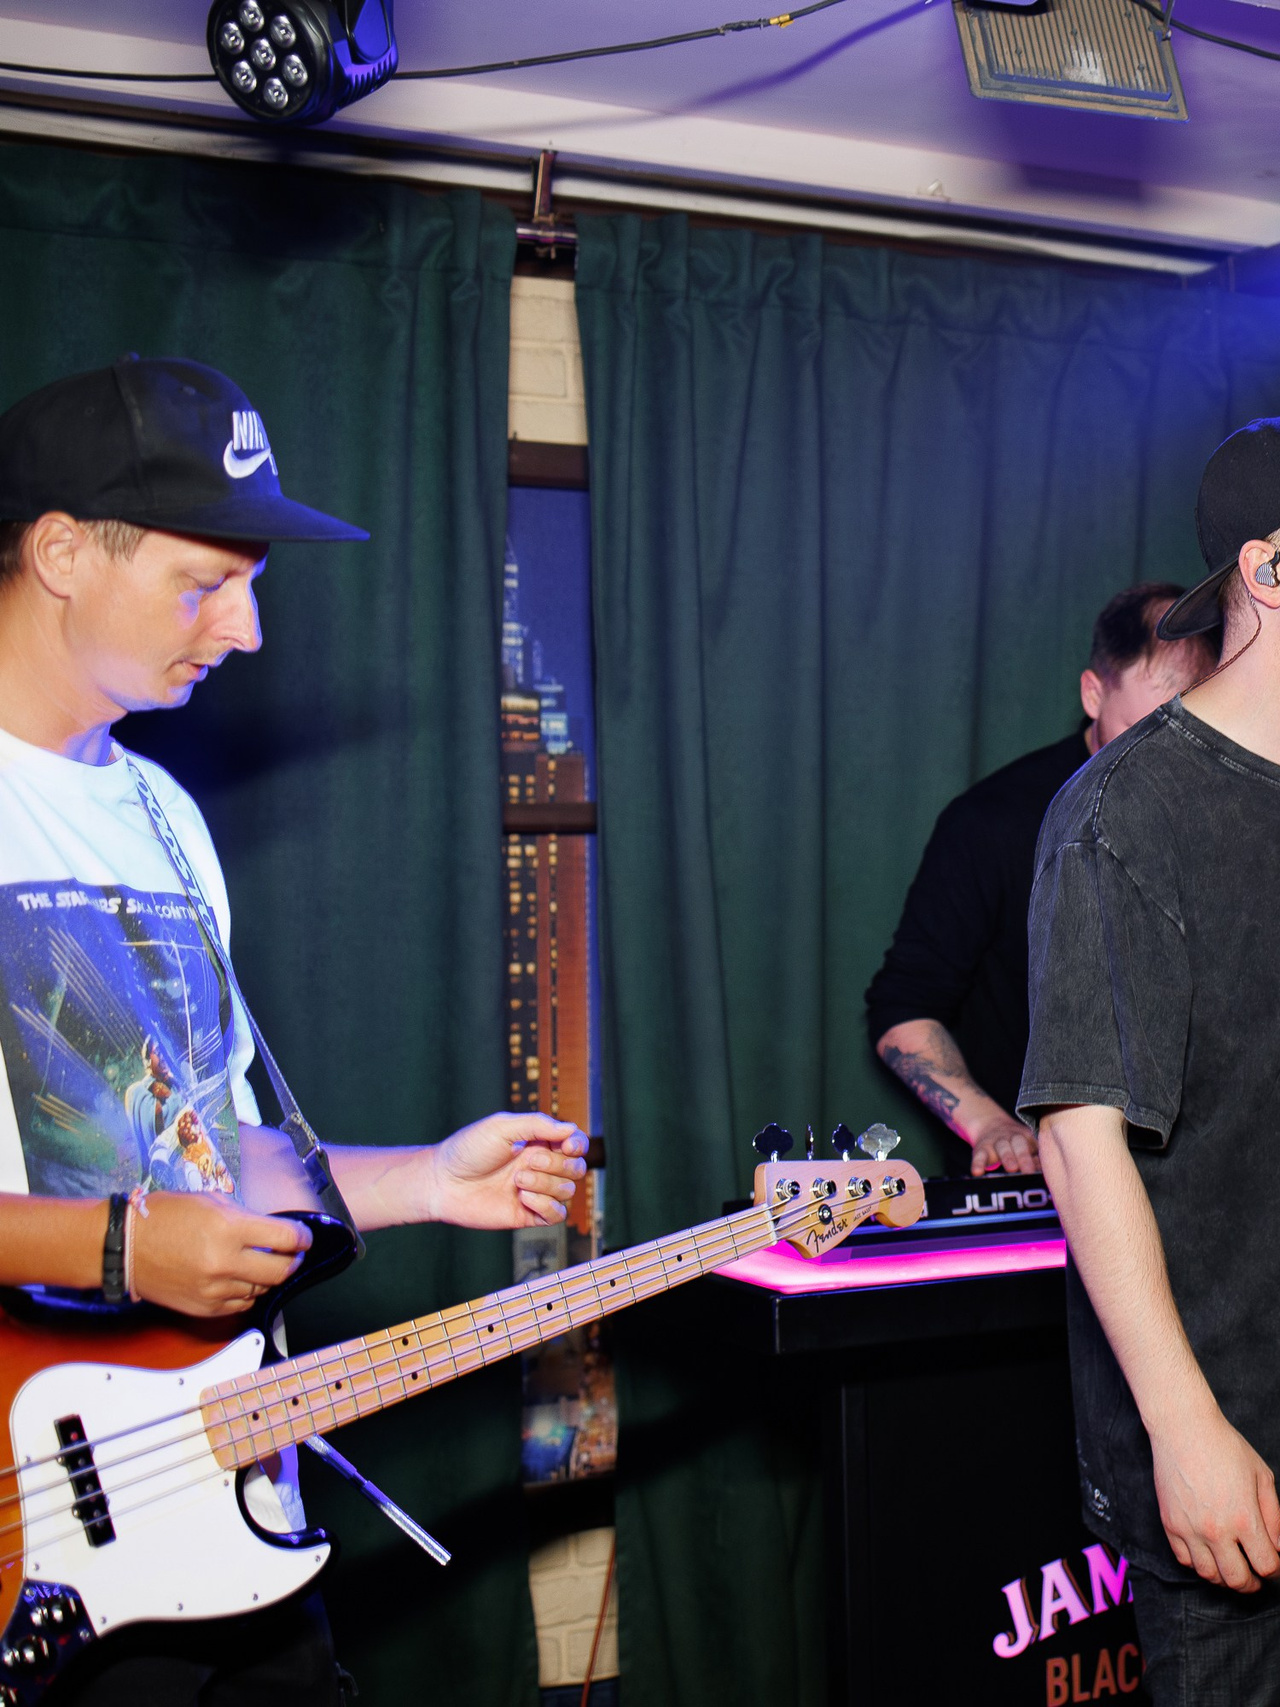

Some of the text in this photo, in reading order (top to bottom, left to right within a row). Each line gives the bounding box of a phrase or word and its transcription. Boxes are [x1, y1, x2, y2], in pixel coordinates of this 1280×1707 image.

[233, 411, 265, 451] NIK
[17, 893, 53, 911] THE
[806, 1217, 848, 1254] Fender
[1046, 1643, 1146, 1707] BLAC
